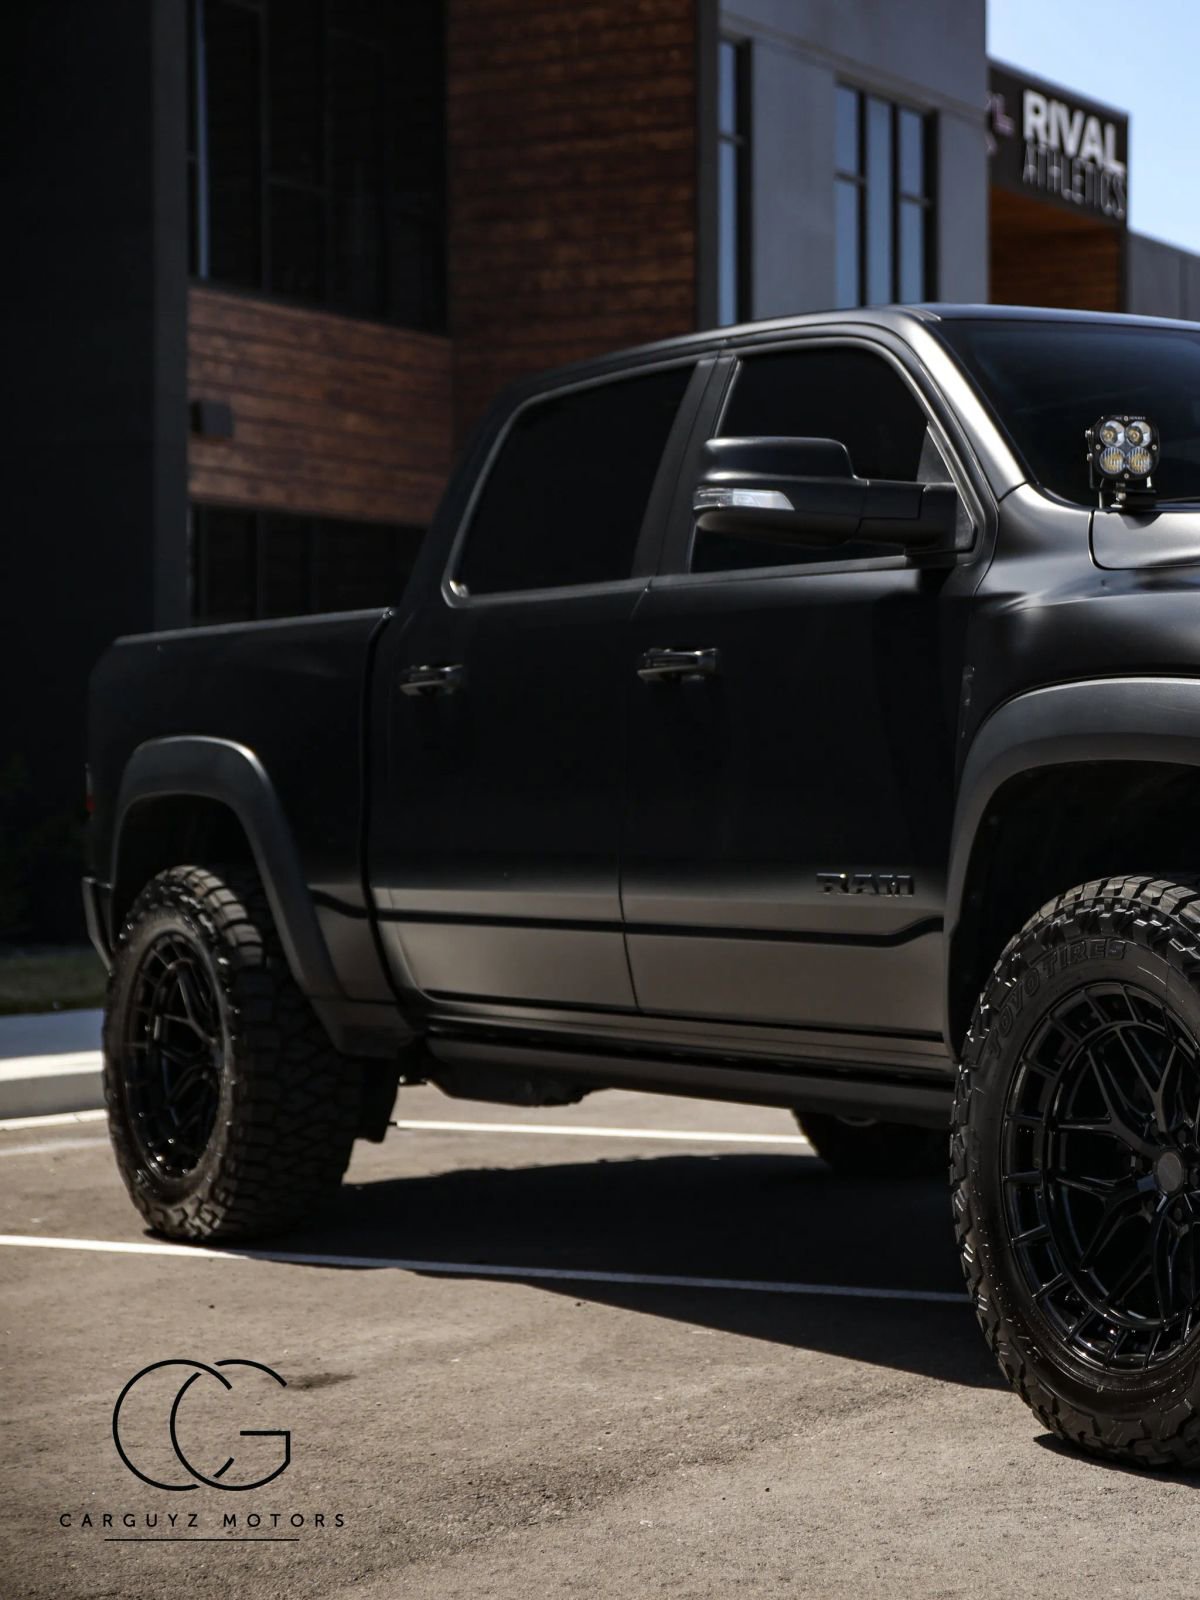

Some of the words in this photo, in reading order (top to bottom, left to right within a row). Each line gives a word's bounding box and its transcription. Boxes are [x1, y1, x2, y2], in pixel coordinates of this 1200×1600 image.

[1022, 88, 1126, 174] RIVAL
[1022, 140, 1126, 218] ATHLETICS
[816, 872, 914, 898] RAM
[1038, 937, 1127, 980] TIRES
